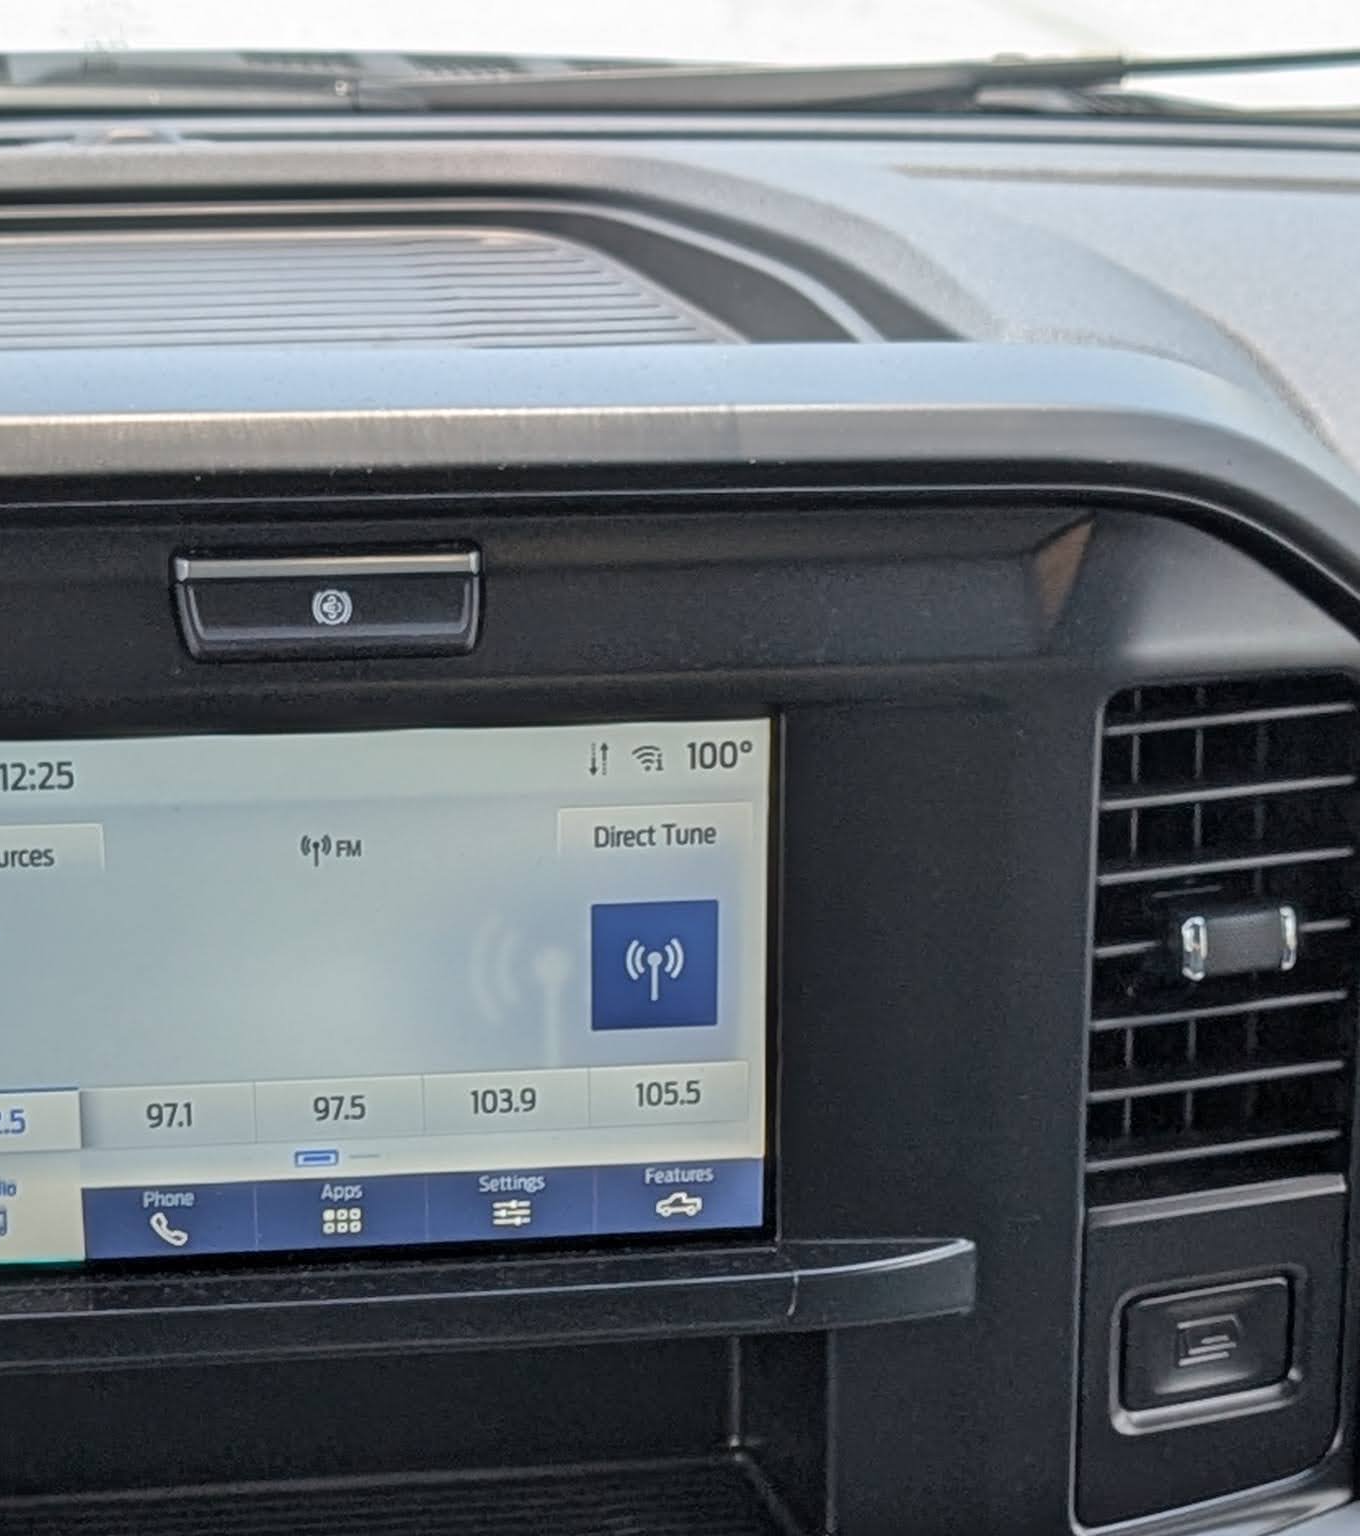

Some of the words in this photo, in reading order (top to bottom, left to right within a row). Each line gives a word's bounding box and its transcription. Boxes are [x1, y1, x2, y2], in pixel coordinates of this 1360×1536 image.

[686, 740, 752, 770] 100°
[335, 840, 362, 858] FM
[593, 825, 656, 849] Direct
[661, 823, 717, 847] Tune
[470, 1087, 536, 1114] 103.9
[635, 1080, 701, 1107] 105.5
[146, 1102, 193, 1129] 97.1
[313, 1095, 367, 1121] 97.5
[479, 1174, 546, 1194] Settings
[644, 1167, 714, 1184] Features
[142, 1191, 195, 1208] Phone
[321, 1183, 363, 1202] Apps
